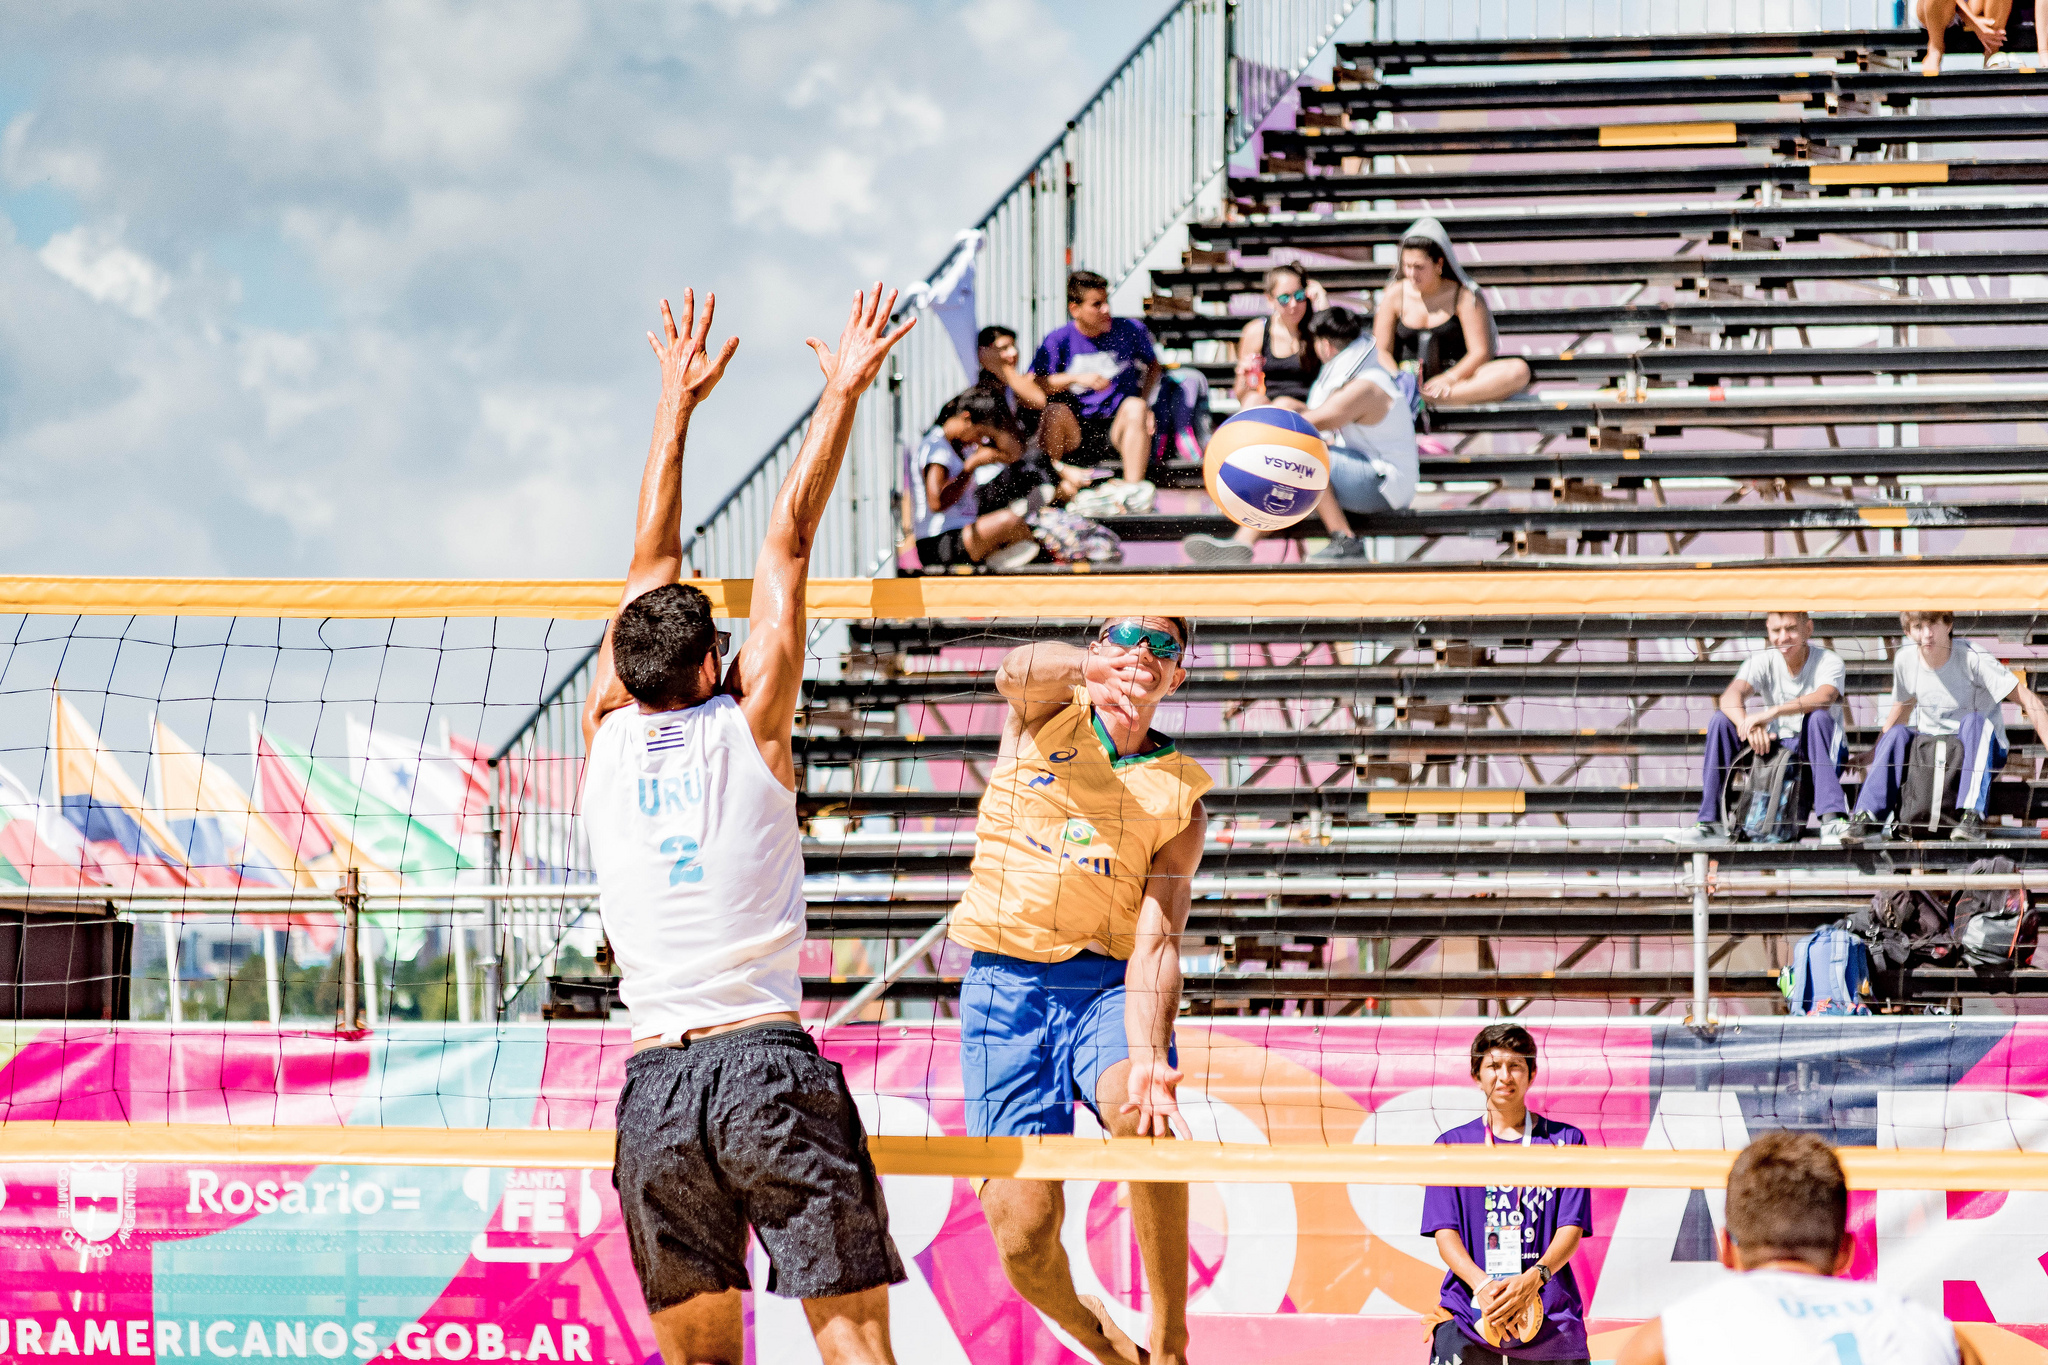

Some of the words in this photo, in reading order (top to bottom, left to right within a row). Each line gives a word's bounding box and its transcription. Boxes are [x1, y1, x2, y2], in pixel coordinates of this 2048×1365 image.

[638, 767, 703, 817] URU
[659, 835, 704, 888] 2
[505, 1169, 566, 1189] SANTA
[118, 1166, 138, 1245] ARGENTINO
[502, 1189, 566, 1232] FE
